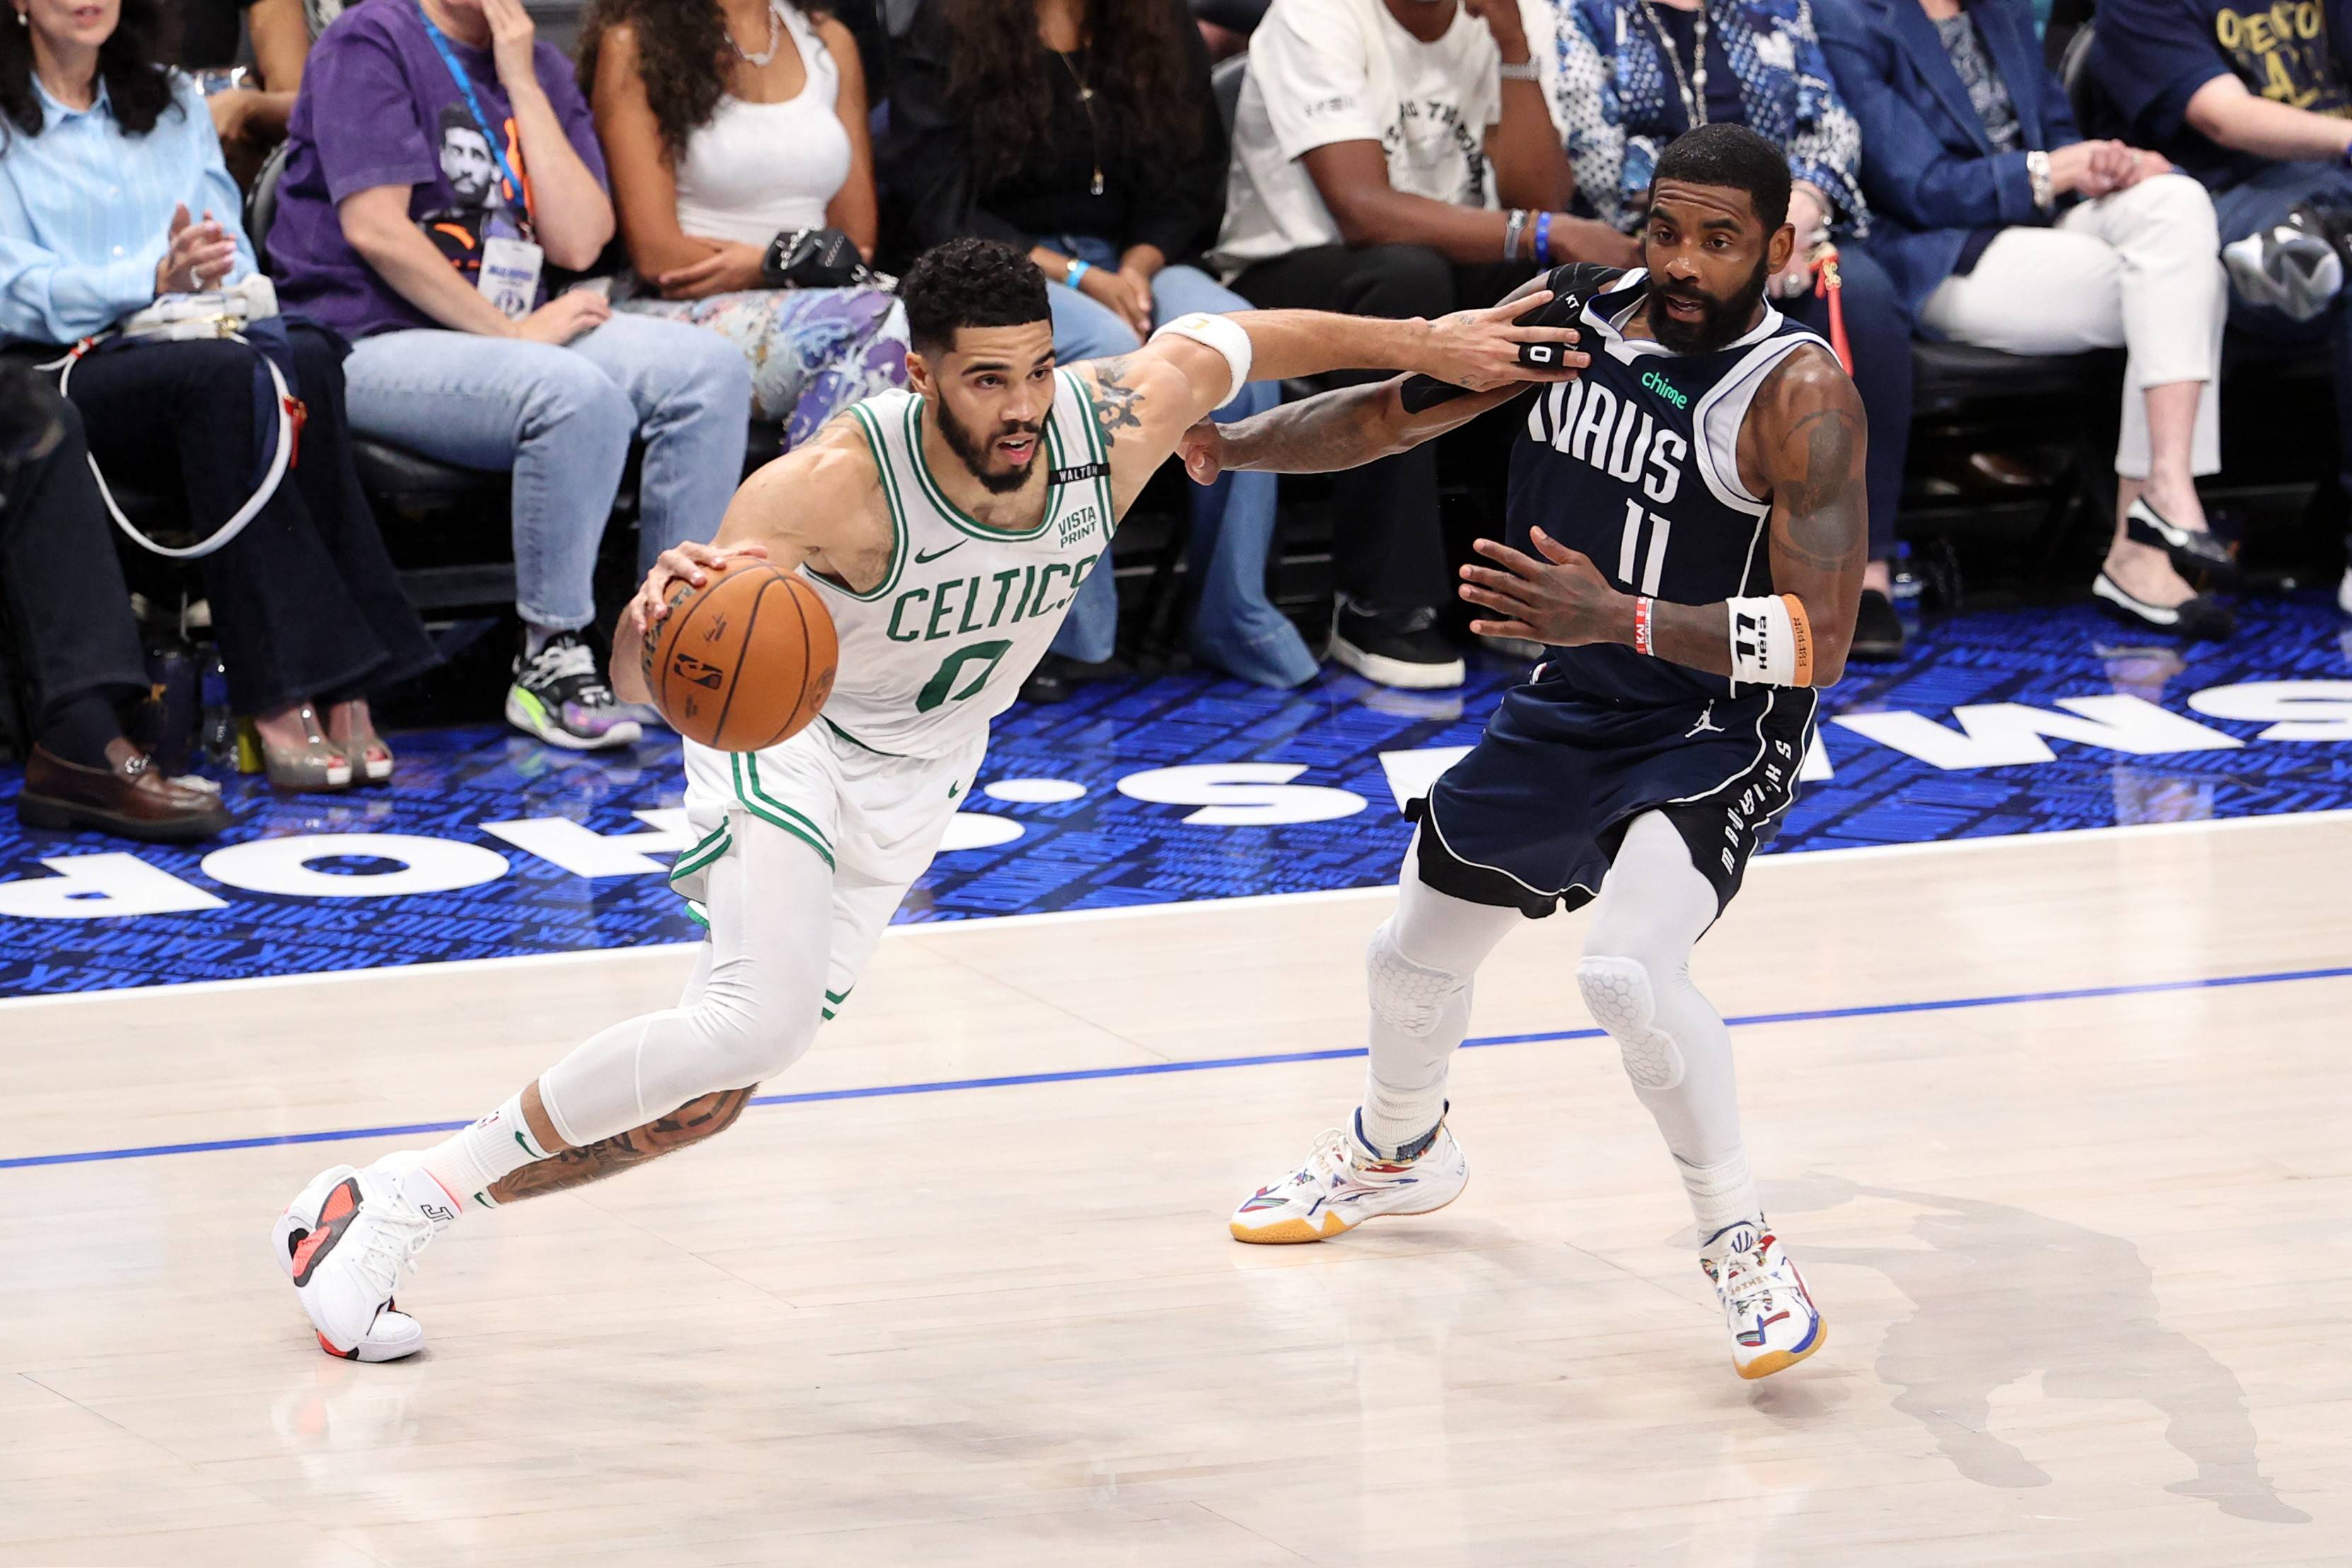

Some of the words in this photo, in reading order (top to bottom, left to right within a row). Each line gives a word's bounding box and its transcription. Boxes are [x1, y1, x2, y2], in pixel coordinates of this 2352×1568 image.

[1564, 293, 1580, 310] KT
[1529, 345, 1552, 363] 0
[1641, 371, 1688, 410] chime
[1059, 464, 1098, 484] WALTON
[1057, 505, 1097, 537] VISTA
[1059, 520, 1098, 549] PRINT
[1617, 497, 1672, 598] 11
[885, 554, 1098, 643] CELTICS
[1735, 612, 1757, 665] 11
[914, 639, 1015, 715] 0
